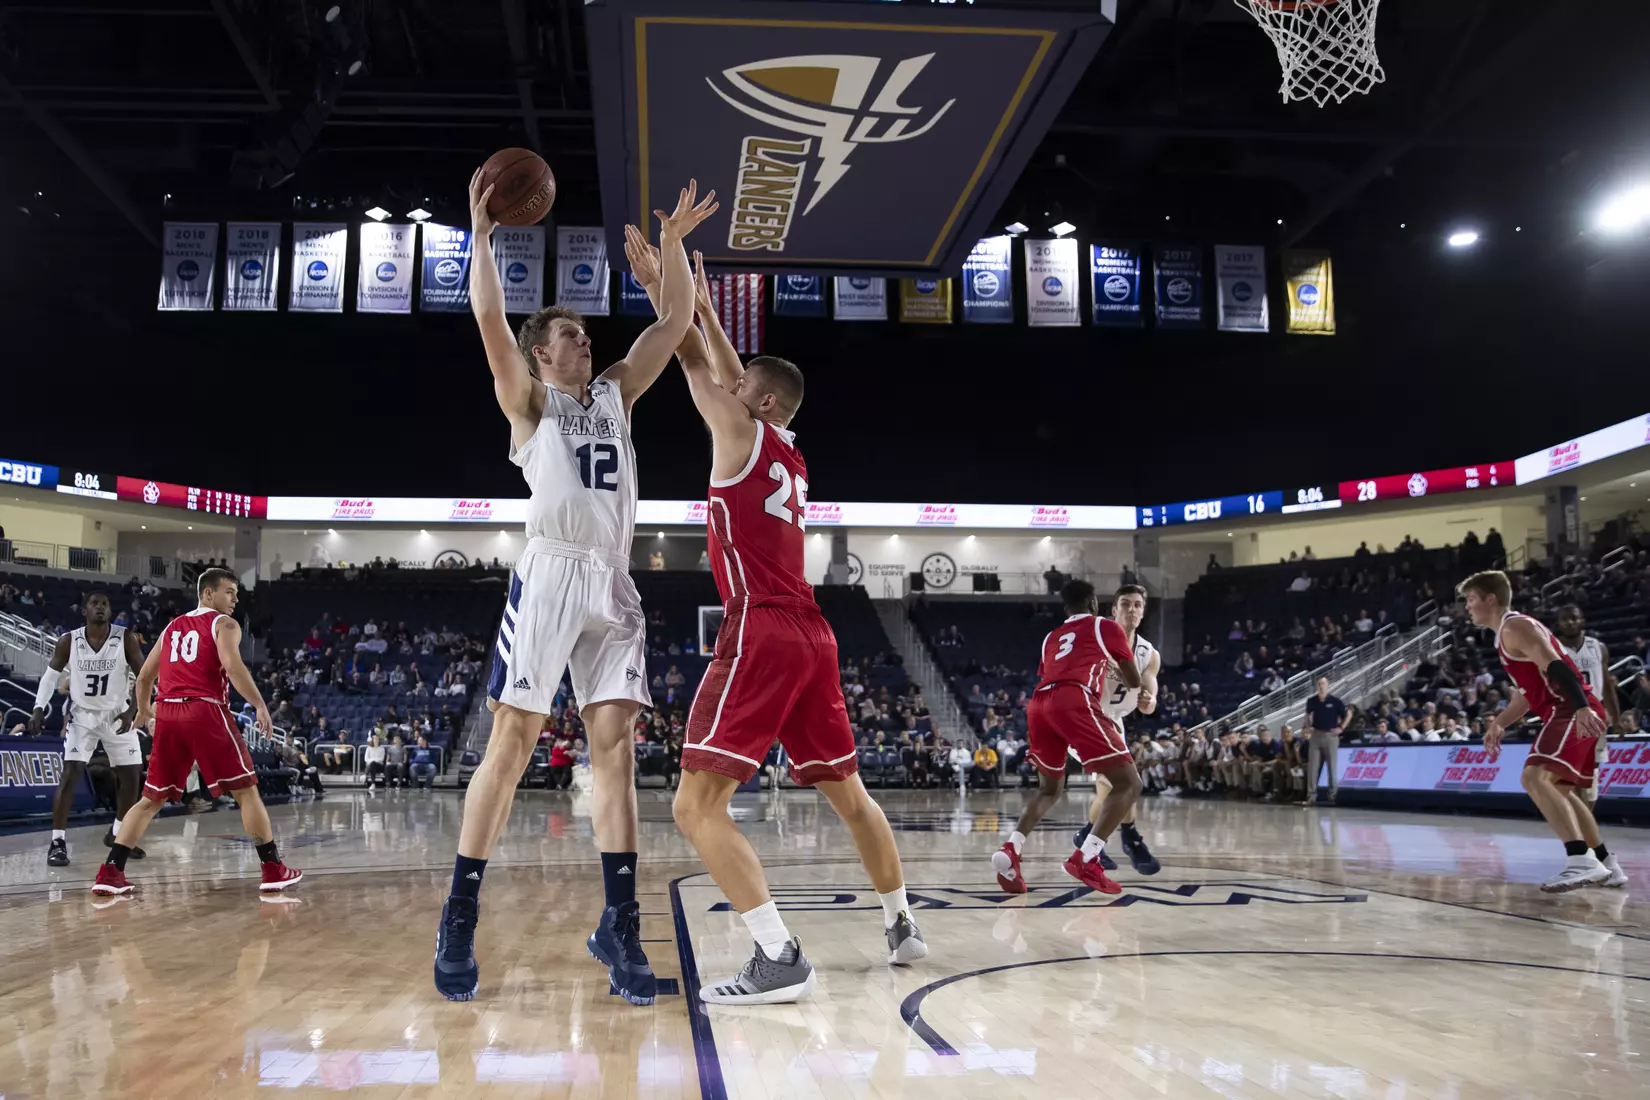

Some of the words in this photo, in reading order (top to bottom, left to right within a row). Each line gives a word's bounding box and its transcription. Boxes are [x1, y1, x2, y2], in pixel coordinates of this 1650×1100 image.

[728, 135, 812, 252] LANCERS
[174, 229, 206, 240] 2018
[237, 229, 269, 240] 2018
[305, 229, 335, 240] 2017
[374, 231, 403, 241] 016
[437, 230, 465, 242] 016
[503, 232, 534, 243] 2015
[568, 234, 598, 244] 2014
[505, 244, 530, 252] MEN'S
[1100, 246, 1130, 259] 2017
[366, 251, 411, 259] ASKETBALL
[1096, 257, 1134, 267] WOMEN'S
[915, 281, 937, 289] NCAA
[292, 291, 340, 299] TOURNAMENT
[360, 292, 409, 300] TOURNAMENT
[777, 292, 824, 301] CHAMPIONS
[963, 299, 1010, 308] CHAMPIONS
[1094, 303, 1140, 312] CHAMPIONS
[576, 443, 619, 492] 12
[0, 461, 42, 486] CBU
[74, 472, 100, 491] 8:04
[1357, 480, 1377, 502] 28
[340, 498, 373, 508] Bud's
[458, 499, 491, 508] Bud's
[809, 503, 840, 512] Bud's
[1247, 494, 1265, 514] 16
[923, 505, 955, 513] Bud's
[1036, 507, 1068, 515] Bud's
[1184, 500, 1222, 521] CBU
[169, 629, 200, 664] 10
[1054, 631, 1076, 661] 3
[76, 658, 117, 672] LANCERS
[84, 673, 110, 697] 31
[1109, 682, 1127, 705] 5
[1352, 747, 1389, 765] Bud's
[1454, 747, 1499, 764] Buds
[1607, 742, 1650, 765] ud's
[0, 750, 63, 787] ANCER
[1343, 766, 1363, 780] TIRE
[1361, 766, 1389, 781] PROS
[1440, 767, 1468, 785] TIRE
[1463, 767, 1500, 787] PROS
